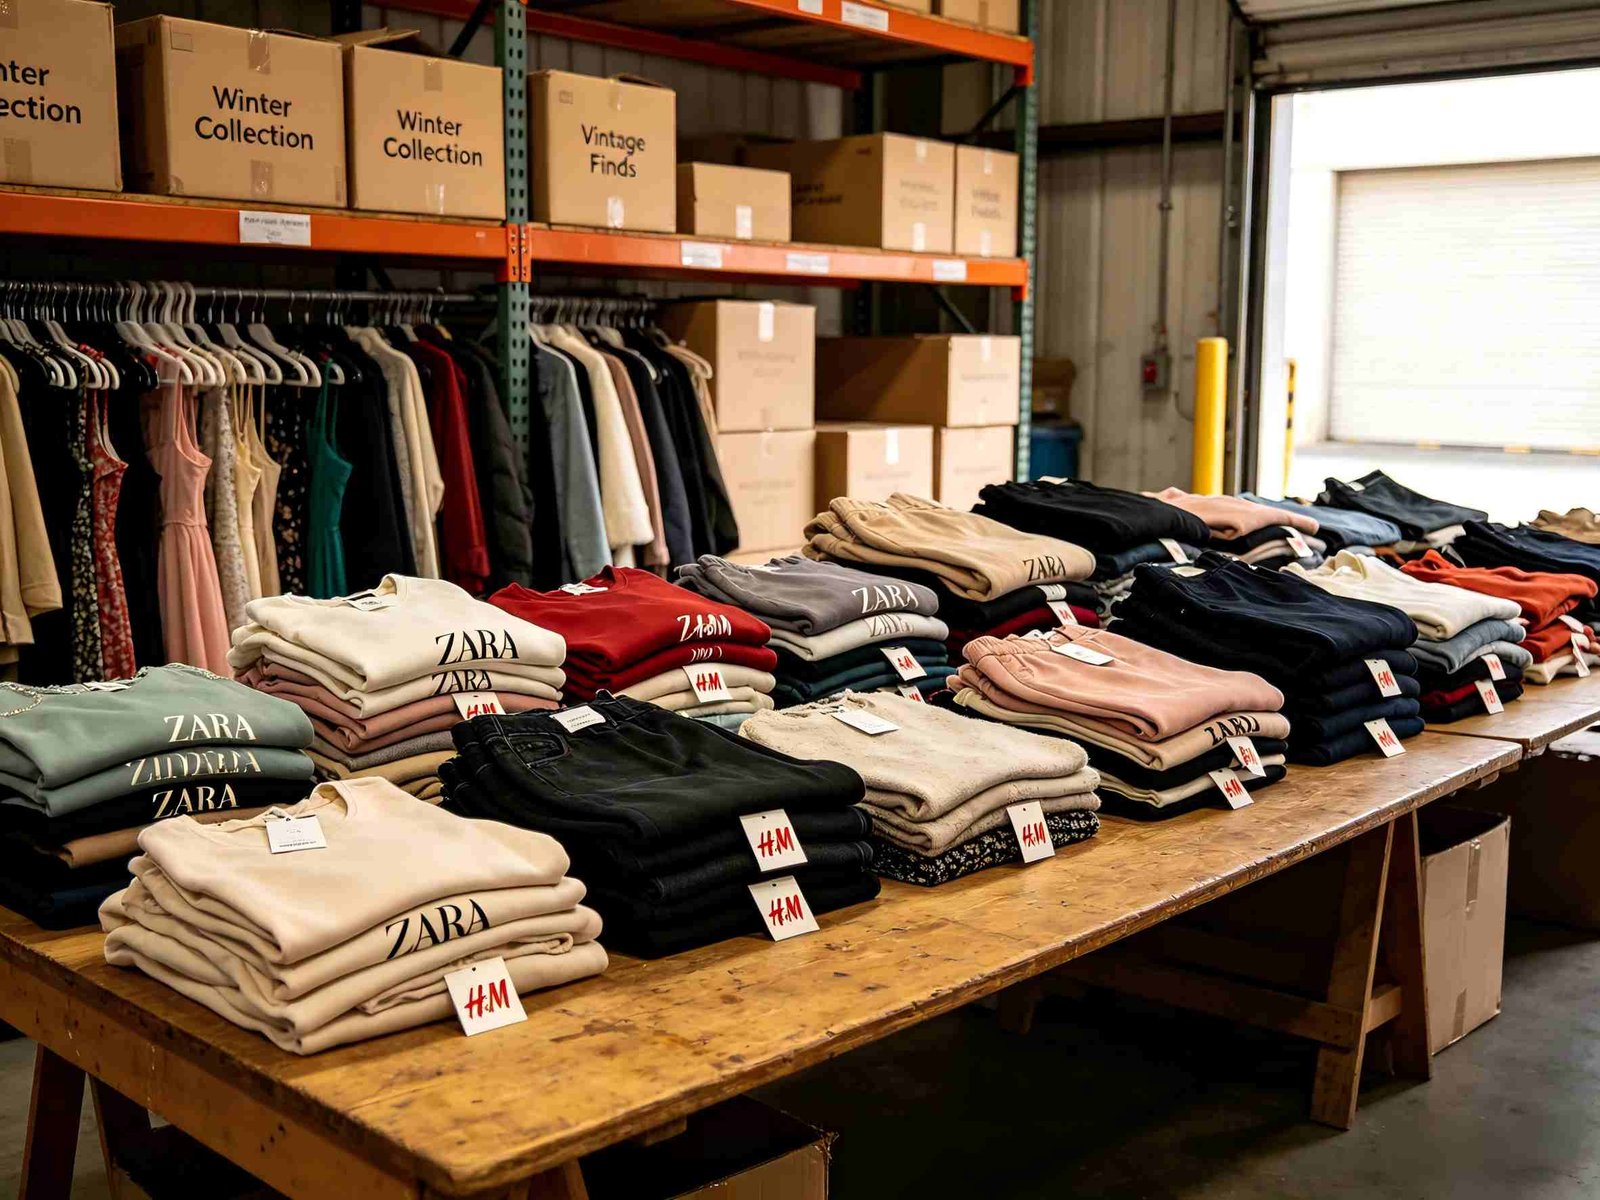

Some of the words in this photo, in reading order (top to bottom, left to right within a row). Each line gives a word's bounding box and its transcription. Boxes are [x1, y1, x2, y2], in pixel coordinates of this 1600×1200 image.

[213, 86, 292, 118] Winter
[195, 116, 314, 151] Collection
[397, 109, 462, 137] Winter
[384, 137, 483, 167] Collection
[582, 124, 646, 155] Vintage
[590, 153, 637, 178] Finds
[435, 629, 520, 666] ZARA
[431, 669, 493, 696] ZARA
[163, 713, 257, 743] ZARA
[152, 783, 239, 819] ZARA
[385, 898, 490, 960] ZARA
